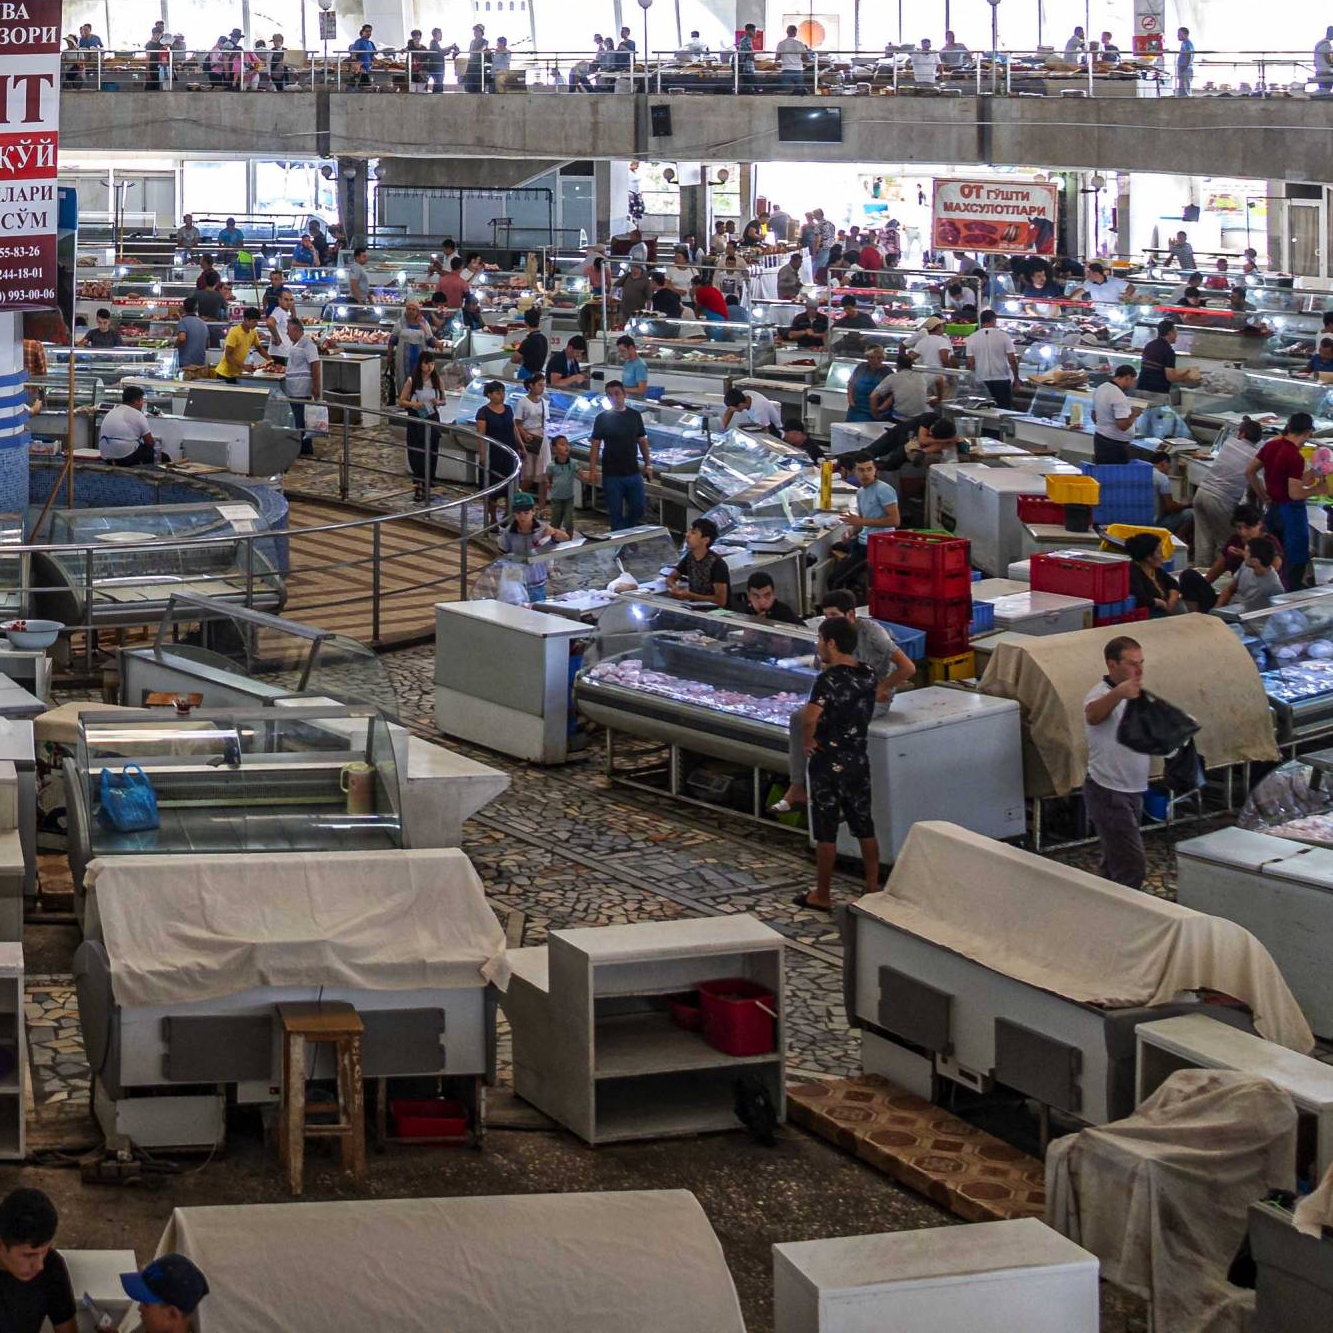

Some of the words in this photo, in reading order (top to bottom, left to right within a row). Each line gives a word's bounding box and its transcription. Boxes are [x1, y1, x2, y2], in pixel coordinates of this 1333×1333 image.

[960, 184, 984, 199] ОТ
[943, 202, 1046, 217] МАХСУЛОТЛАРИ
[0, 208, 48, 229] СЎМ
[8, 288, 55, 301] 993-00-06
